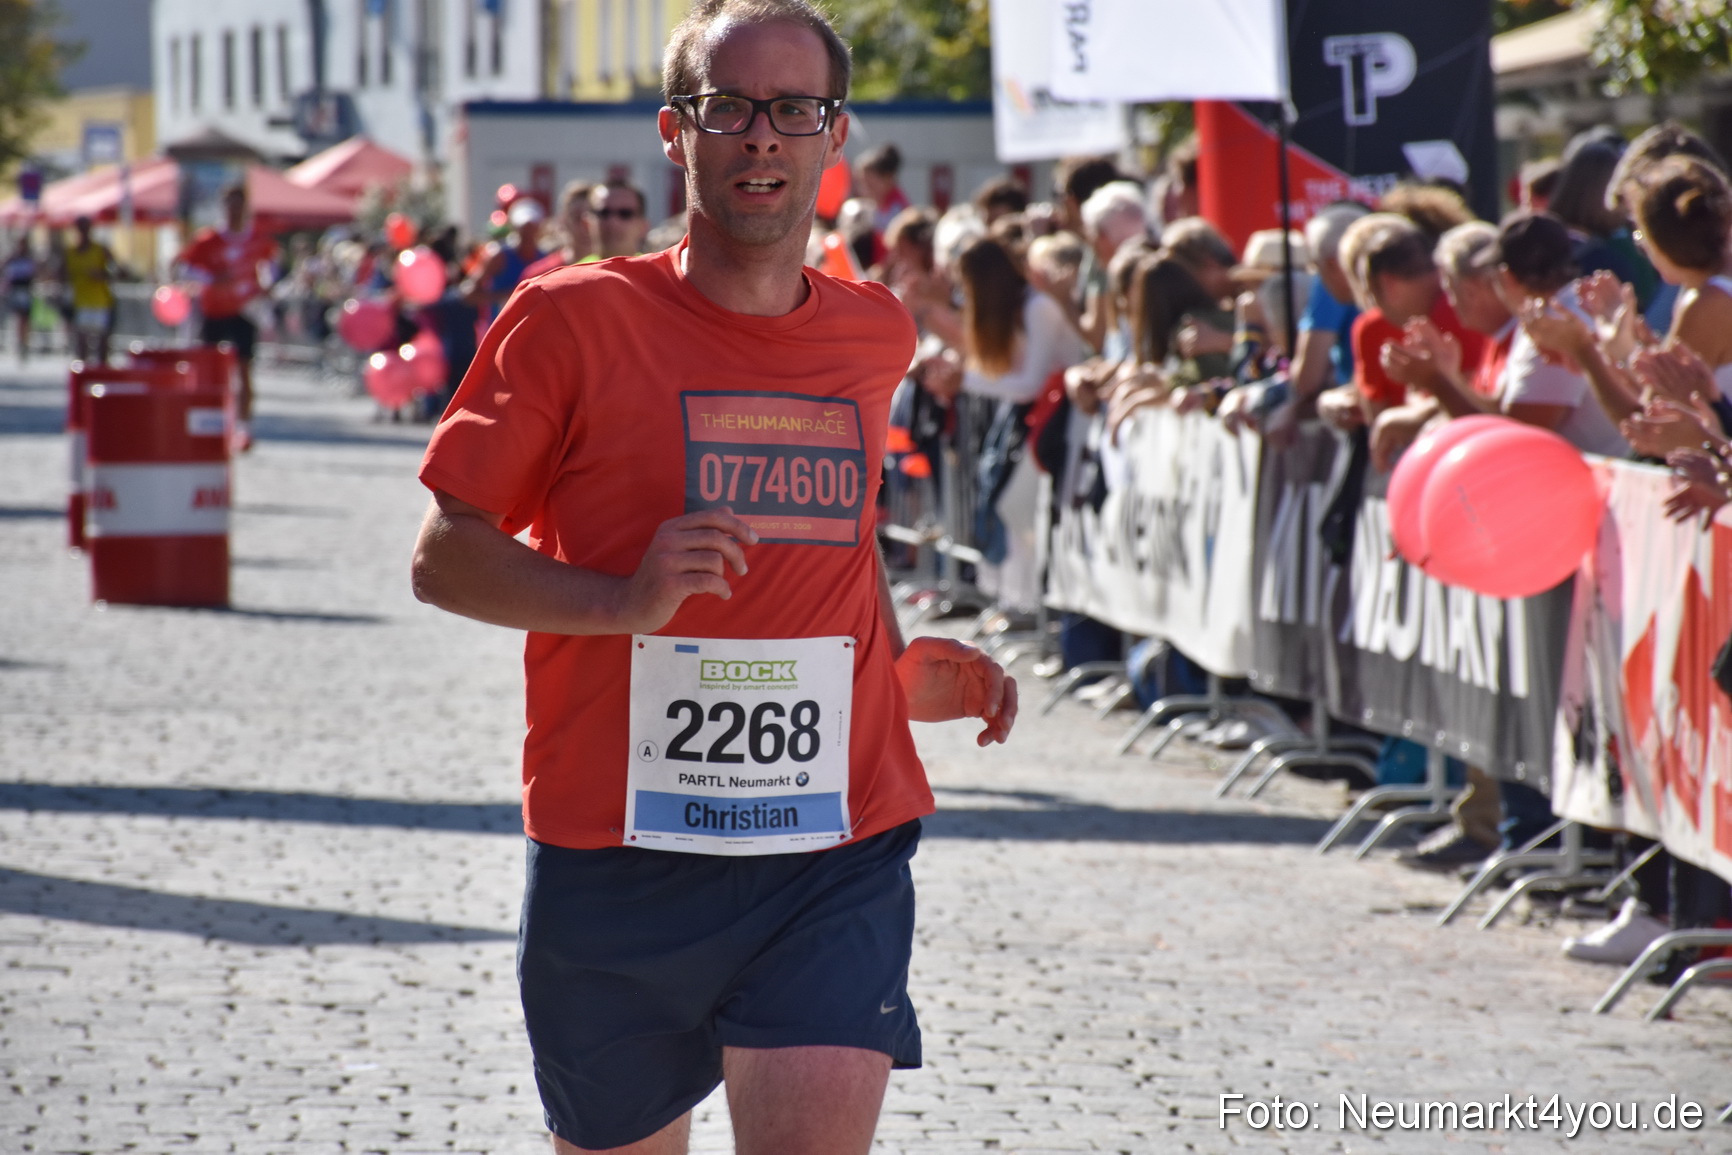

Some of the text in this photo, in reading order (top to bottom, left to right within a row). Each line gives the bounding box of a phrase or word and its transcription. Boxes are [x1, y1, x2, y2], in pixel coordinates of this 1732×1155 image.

[699, 453, 859, 508] 0774600
[701, 659, 797, 682] BOCK
[732, 683, 741, 691] by
[767, 683, 799, 691] concepts
[665, 699, 821, 764] 2268
[643, 746, 652, 758] A
[679, 773, 791, 788] PARTL Neumarkt
[684, 801, 798, 831] Christian
